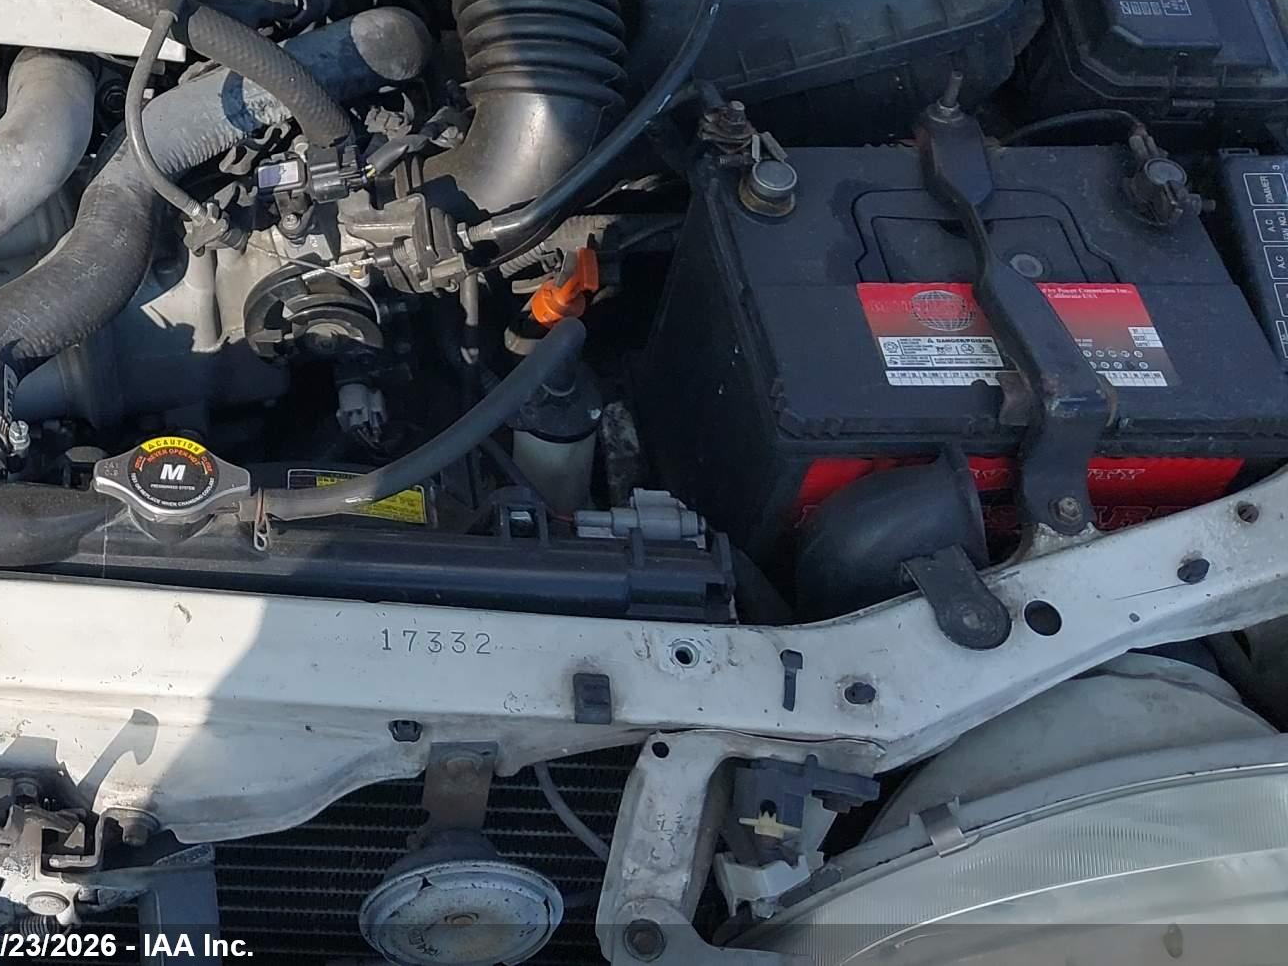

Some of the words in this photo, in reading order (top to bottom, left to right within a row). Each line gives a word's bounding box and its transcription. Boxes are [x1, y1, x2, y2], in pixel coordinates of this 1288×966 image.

[155, 439, 200, 453] CAUTION
[160, 464, 186, 481] M
[381, 628, 492, 655] 17332
